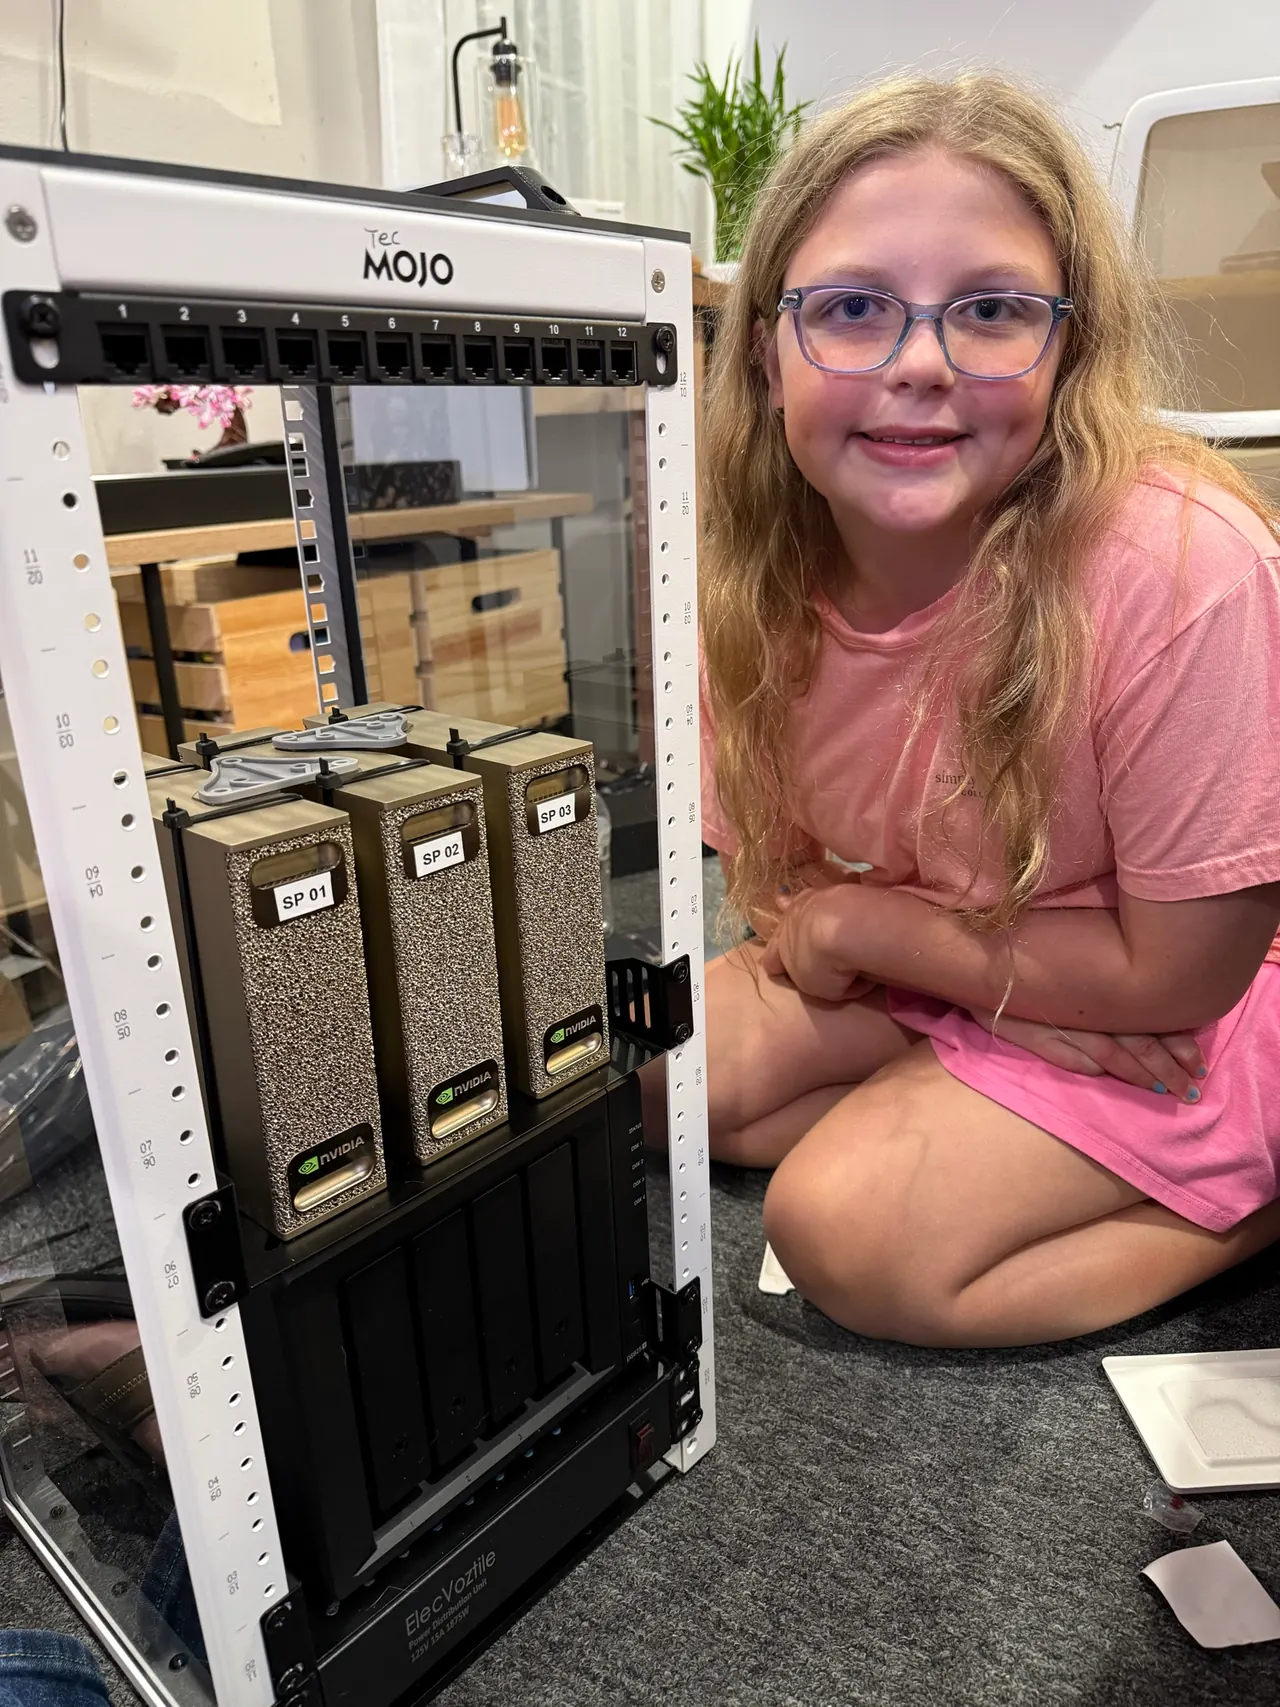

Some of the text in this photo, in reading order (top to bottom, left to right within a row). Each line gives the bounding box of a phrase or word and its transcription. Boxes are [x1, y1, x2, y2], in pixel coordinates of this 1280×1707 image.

[364, 227, 401, 249] Tec
[363, 247, 454, 288] MOJO
[118, 304, 128, 318] 1
[179, 306, 190, 321] 2
[236, 309, 247, 323] 3
[291, 312, 300, 325] 4
[341, 315, 350, 327] 5
[388, 317, 396, 329] 6
[432, 319, 440, 331] 7
[474, 321, 482, 332] 8
[513, 322, 521, 334] 9
[548, 324, 559, 335] 10
[584, 325, 594, 336] 11
[617, 327, 627, 337] 12
[56, 713, 70, 728] 10
[541, 804, 572, 824] SP 03
[423, 843, 460, 865] SP 02
[282, 884, 326, 909] SP 01
[408, 1578, 488, 1651] Power Distribution Unit
